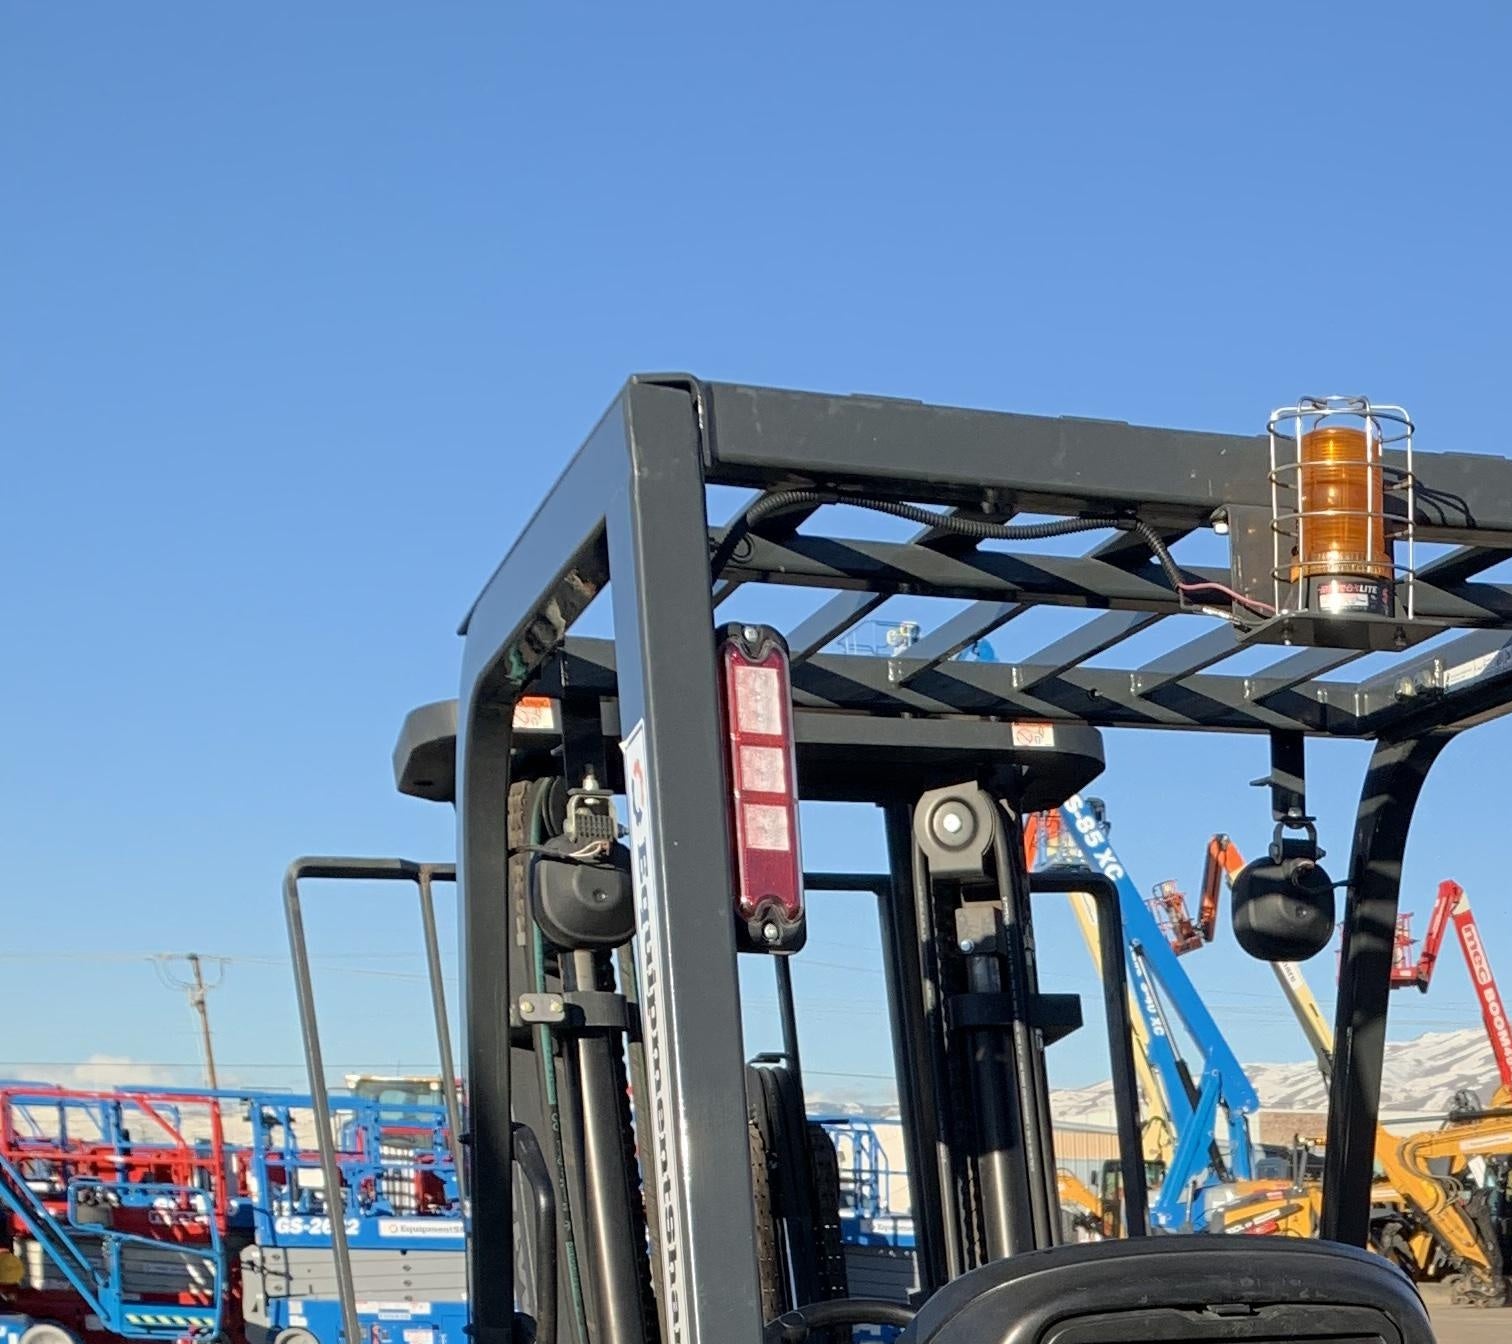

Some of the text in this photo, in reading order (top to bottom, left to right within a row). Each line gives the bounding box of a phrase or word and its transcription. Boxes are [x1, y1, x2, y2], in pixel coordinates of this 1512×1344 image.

[1063, 795, 1124, 882] S-85 XC
[1463, 924, 1489, 985] mec
